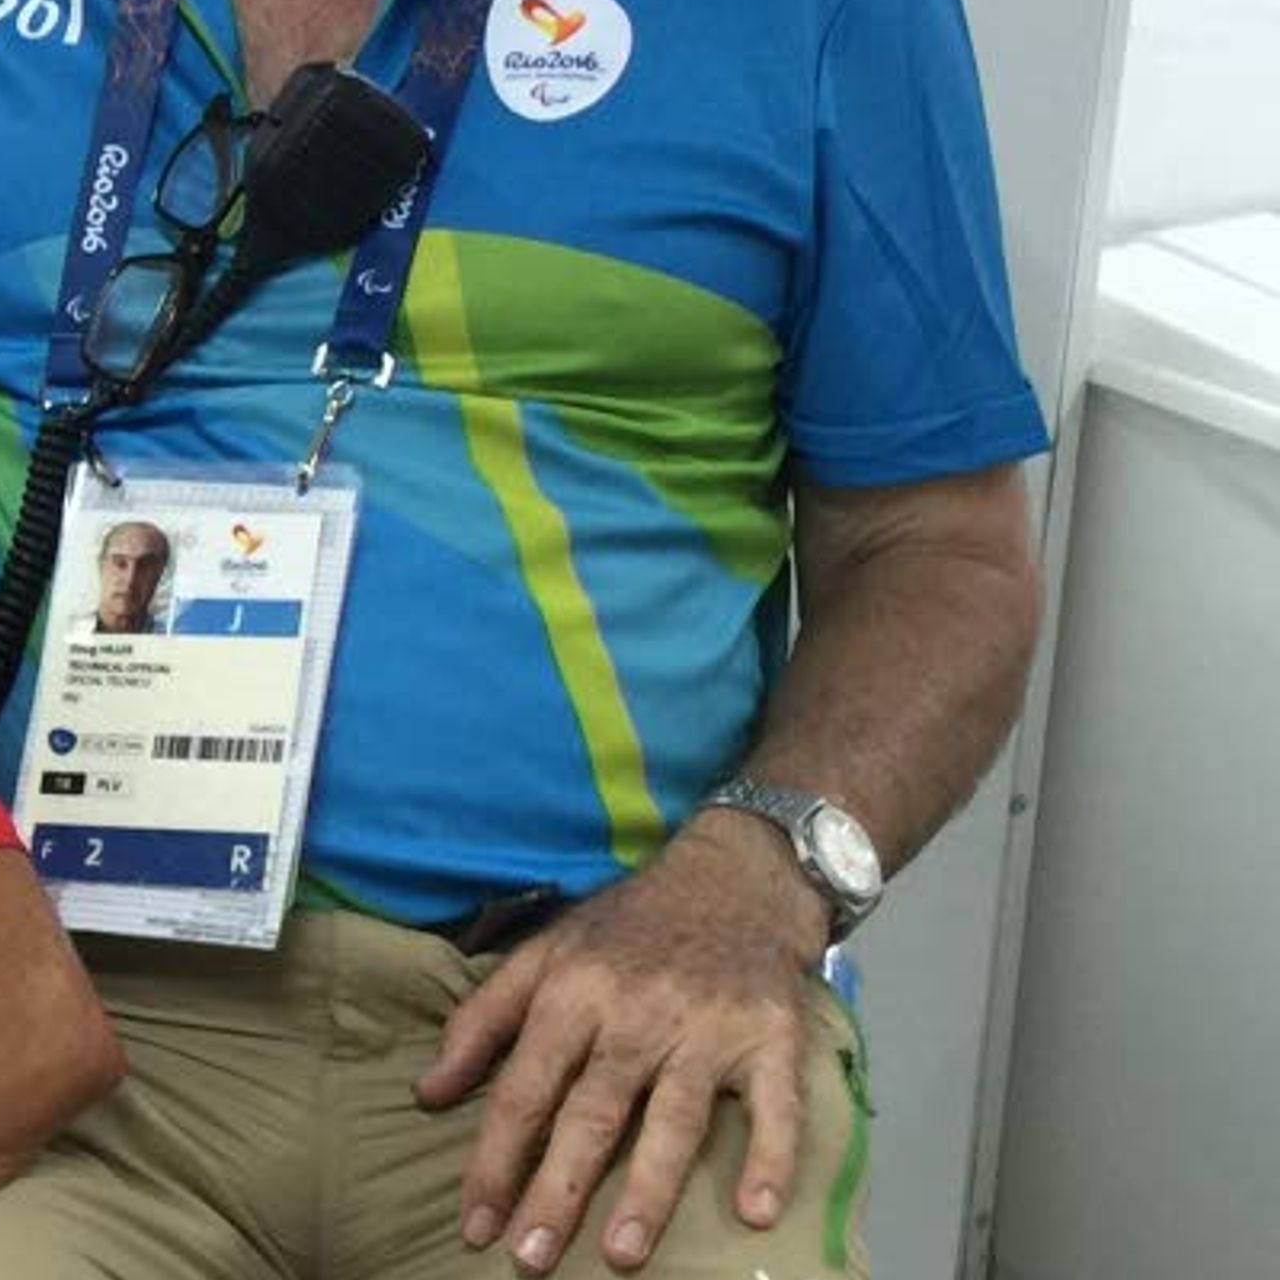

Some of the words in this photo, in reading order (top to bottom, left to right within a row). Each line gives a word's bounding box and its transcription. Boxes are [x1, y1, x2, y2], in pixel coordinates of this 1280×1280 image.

[504, 51, 598, 72] Rio2016
[82, 143, 129, 253] Rio2016
[84, 838, 104, 867] 2
[230, 844, 252, 874] R
